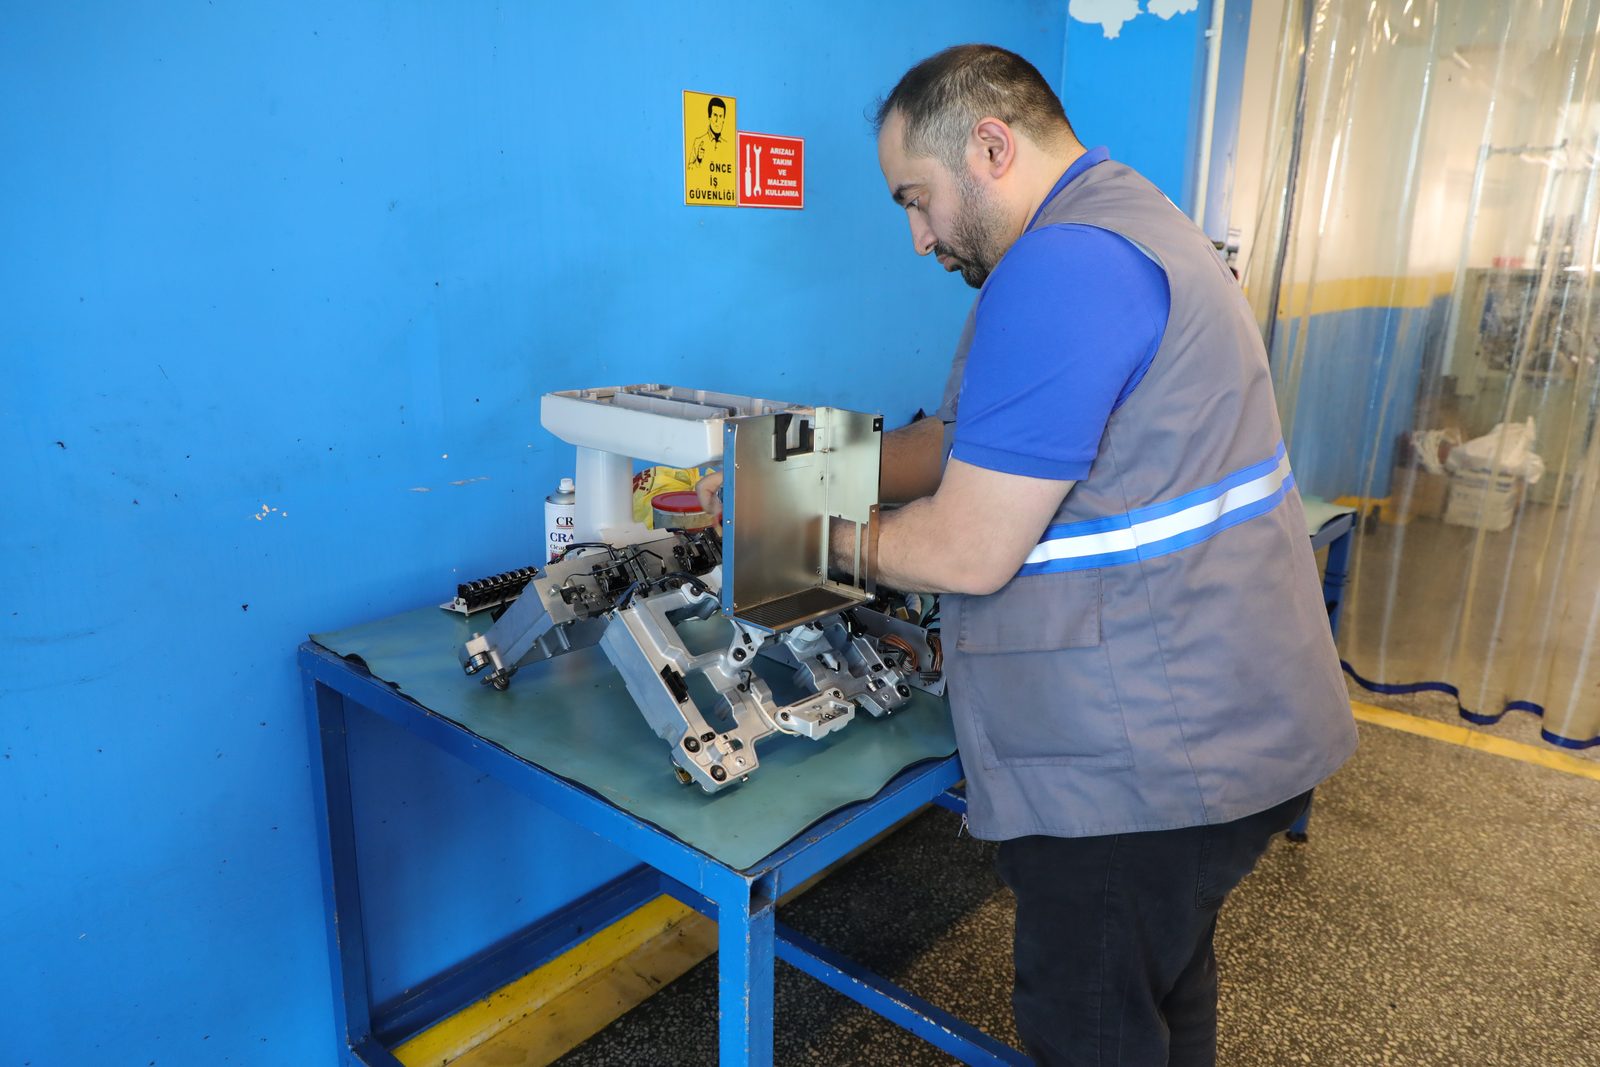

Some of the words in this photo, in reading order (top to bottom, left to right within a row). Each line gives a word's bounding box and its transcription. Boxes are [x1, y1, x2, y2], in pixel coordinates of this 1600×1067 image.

[770, 147, 795, 156] ARIZALI
[772, 158, 793, 166] TAKIM
[709, 161, 732, 174] ÖNCE
[710, 176, 718, 188] İŞ
[767, 179, 797, 187] MALZEME
[689, 189, 735, 201] GÜVENLİĞİ
[765, 189, 799, 197] KULLANMA
